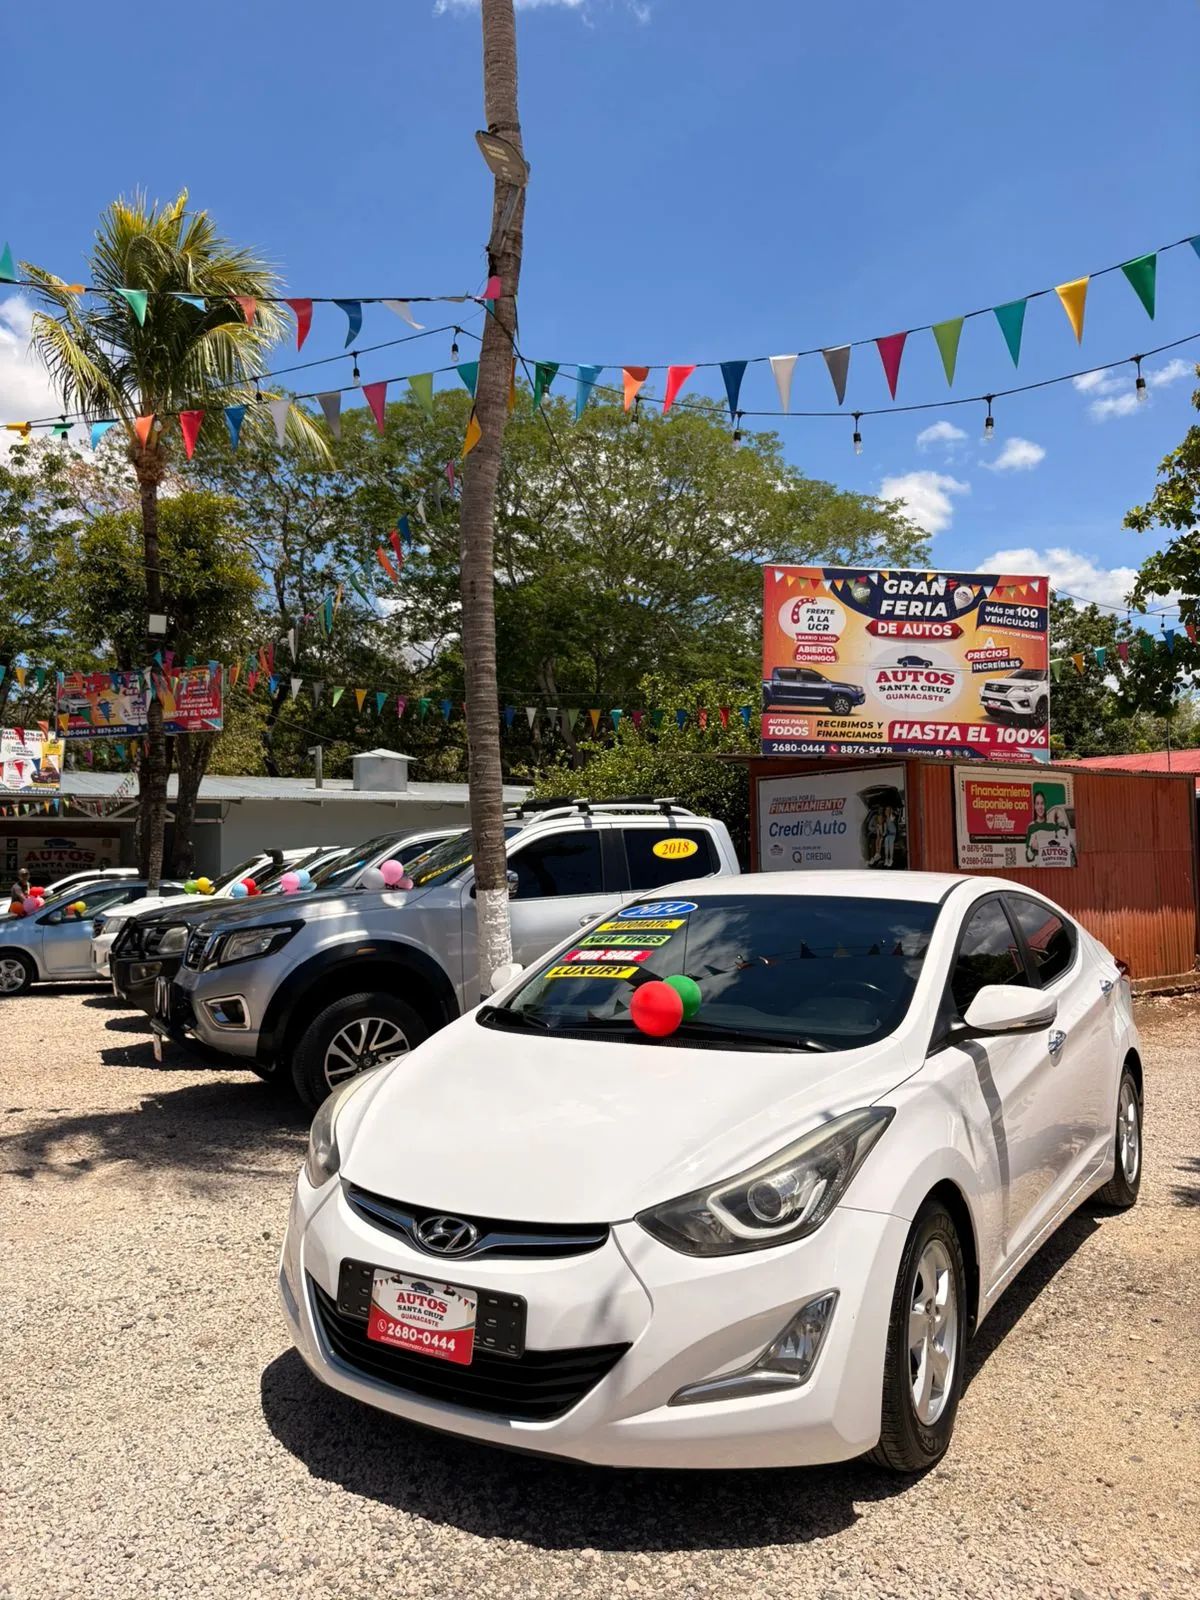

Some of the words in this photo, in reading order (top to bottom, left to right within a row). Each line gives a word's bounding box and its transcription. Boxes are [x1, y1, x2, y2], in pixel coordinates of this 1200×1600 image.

[883, 579, 946, 596] GRAN
[880, 599, 948, 617] FERIA
[1016, 607, 1039, 618] 100
[807, 623, 830, 631] UCR
[984, 615, 1039, 628] VEHÍCULOS!
[877, 622, 898, 634] DE
[901, 623, 953, 636] AUTOS
[798, 646, 834, 654] ABIERTO
[967, 648, 1008, 660] PRECIOS
[796, 654, 836, 662] DOMINGOS
[973, 660, 1021, 671] INCREÍBLES
[876, 670, 955, 686] AUTOS
[920, 685, 951, 694] CRUZ
[885, 693, 945, 702] GUANACASTE
[817, 720, 874, 729] RECIBIMOS
[877, 721, 884, 729] Y
[768, 726, 809, 737] TODOS
[817, 731, 883, 739] FINANCIAMOS
[892, 724, 962, 741] HASTA
[966, 726, 991, 743] EL
[996, 727, 1046, 745] 100%
[772, 743, 826, 753] 2680-0444
[970, 784, 1031, 797] Financiamiento
[771, 799, 845, 814] FINANCIAMIENTO
[972, 797, 1014, 812] disponible
[1014, 800, 1029, 811] con
[769, 820, 804, 837] Credi
[812, 820, 847, 835] Auto
[661, 841, 690, 855] 2018
[1041, 847, 1069, 857] AUTOS
[25, 850, 96, 863] AUTOS
[607, 920, 673, 930] AUTOMATIC
[584, 935, 619, 944] NEW
[620, 935, 666, 944] TIRES
[553, 966, 629, 976] LUXURY
[395, 1291, 448, 1314] AUTOS
[397, 1304, 423, 1315] SANTA
[423, 1309, 445, 1321] CRUZ
[400, 1312, 439, 1328] GUANACASTE
[387, 1322, 457, 1352] 2680-0444
